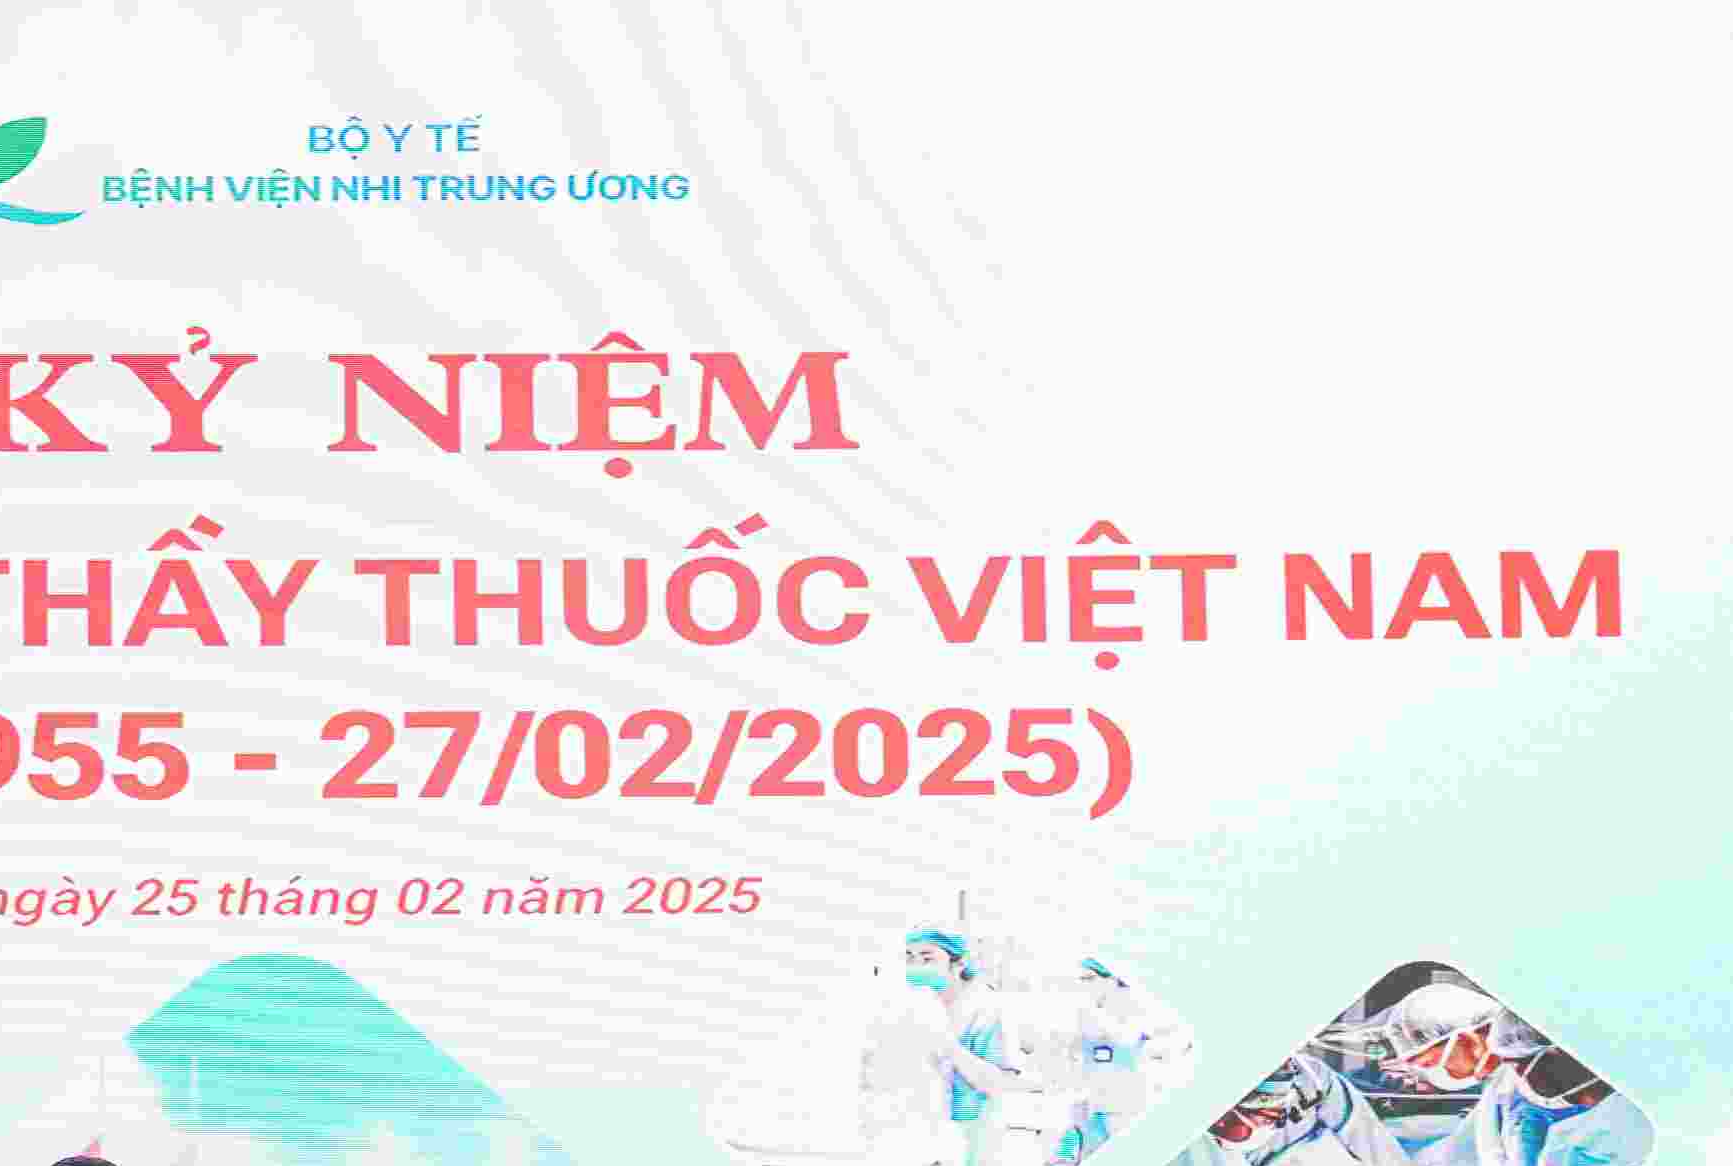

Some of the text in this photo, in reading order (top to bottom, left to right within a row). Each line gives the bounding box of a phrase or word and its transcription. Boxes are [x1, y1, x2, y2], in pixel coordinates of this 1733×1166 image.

[308, 113, 483, 158] BỘ Y TẾ
[102, 167, 691, 209] BỆNH VIỆN NHI TRUNG ƯƠNG
[329, 330, 858, 479] NIỆM
[354, 513, 870, 647] THUỐC
[906, 519, 1237, 671] VIỆT
[1283, 549, 1624, 641] NAM
[234, 752, 276, 772] -
[320, 708, 1132, 818] 27/02/2025)
[130, 879, 202, 917] 25
[216, 878, 379, 927] tháng
[396, 880, 464, 916] 02
[483, 878, 603, 915] năm
[623, 877, 763, 915] 2025
